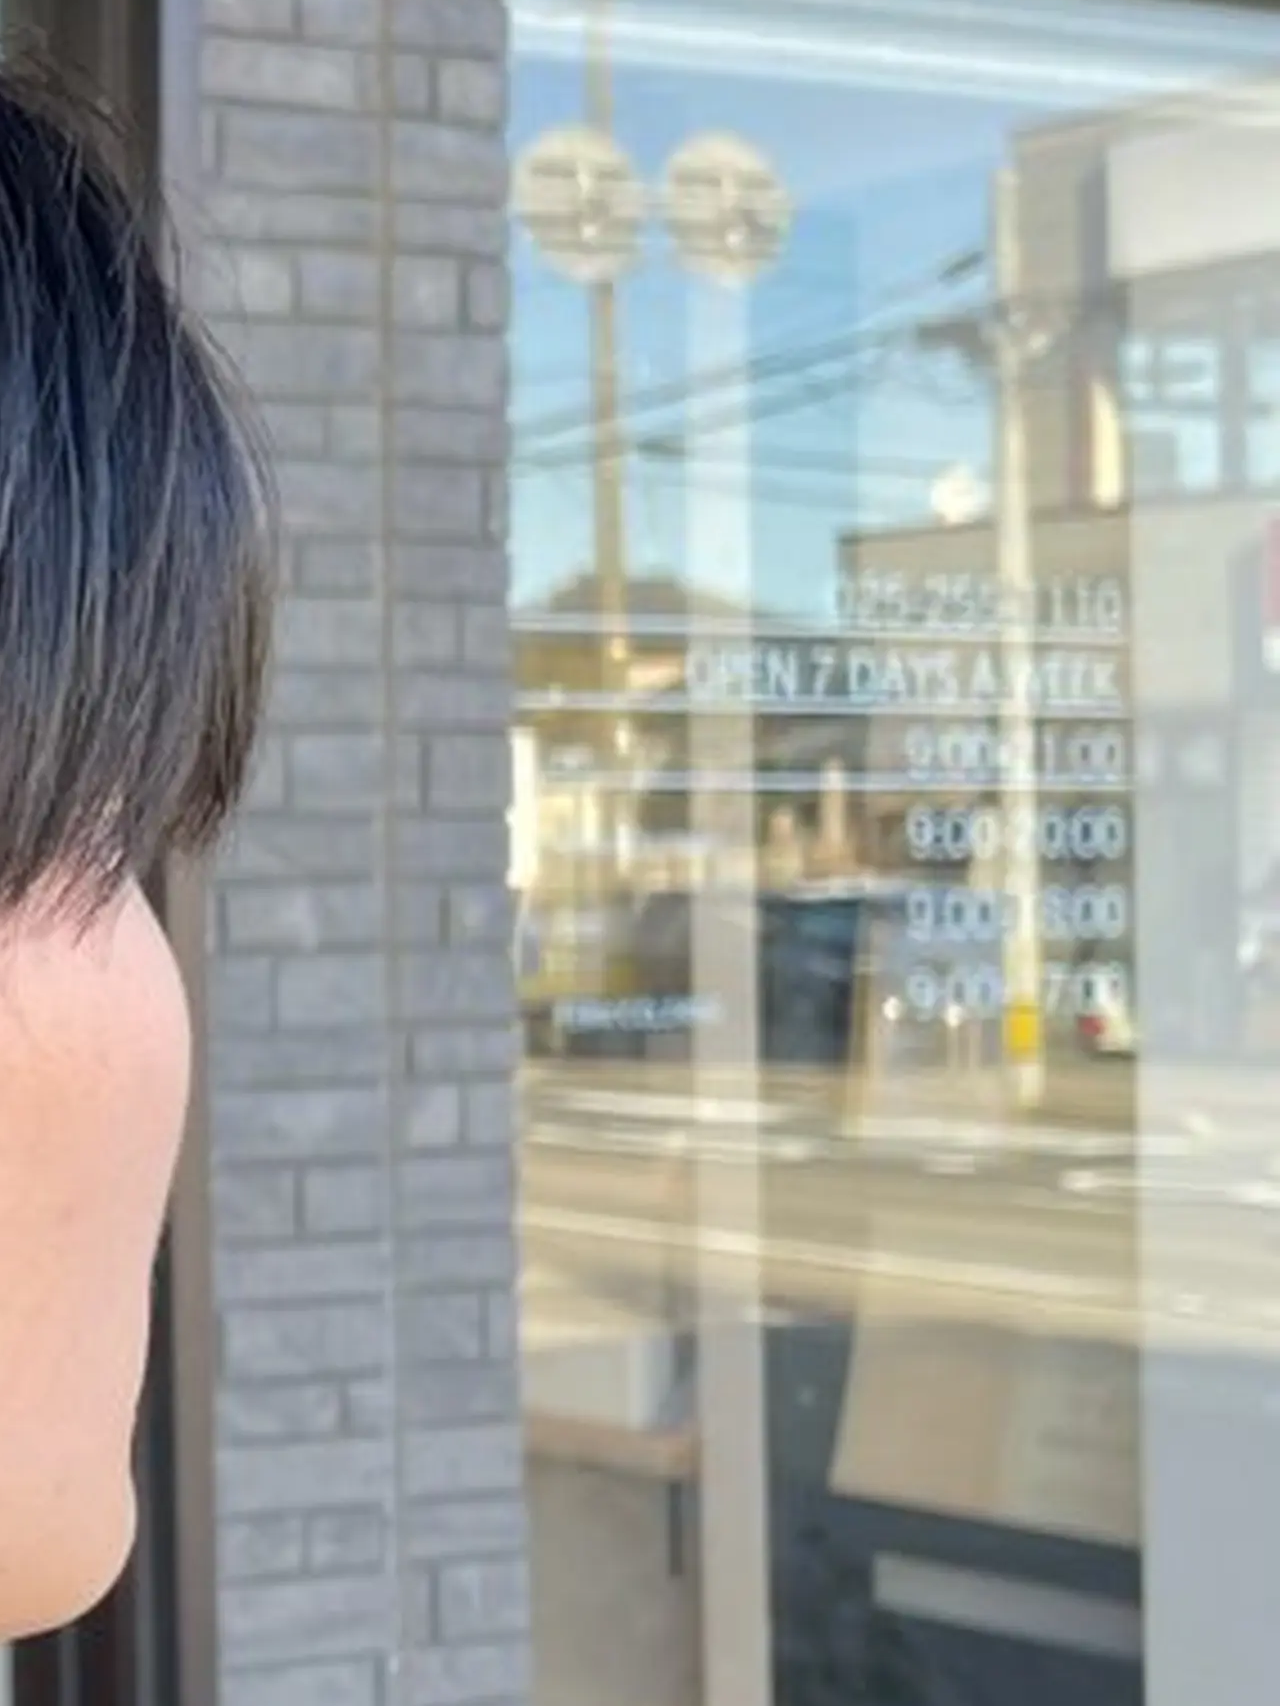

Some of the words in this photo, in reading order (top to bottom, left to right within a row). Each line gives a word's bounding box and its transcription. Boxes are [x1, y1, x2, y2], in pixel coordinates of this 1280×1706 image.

[686, 646, 797, 700] OPEN
[810, 646, 837, 700] 7
[848, 648, 957, 703] DAYS
[970, 649, 996, 704] A
